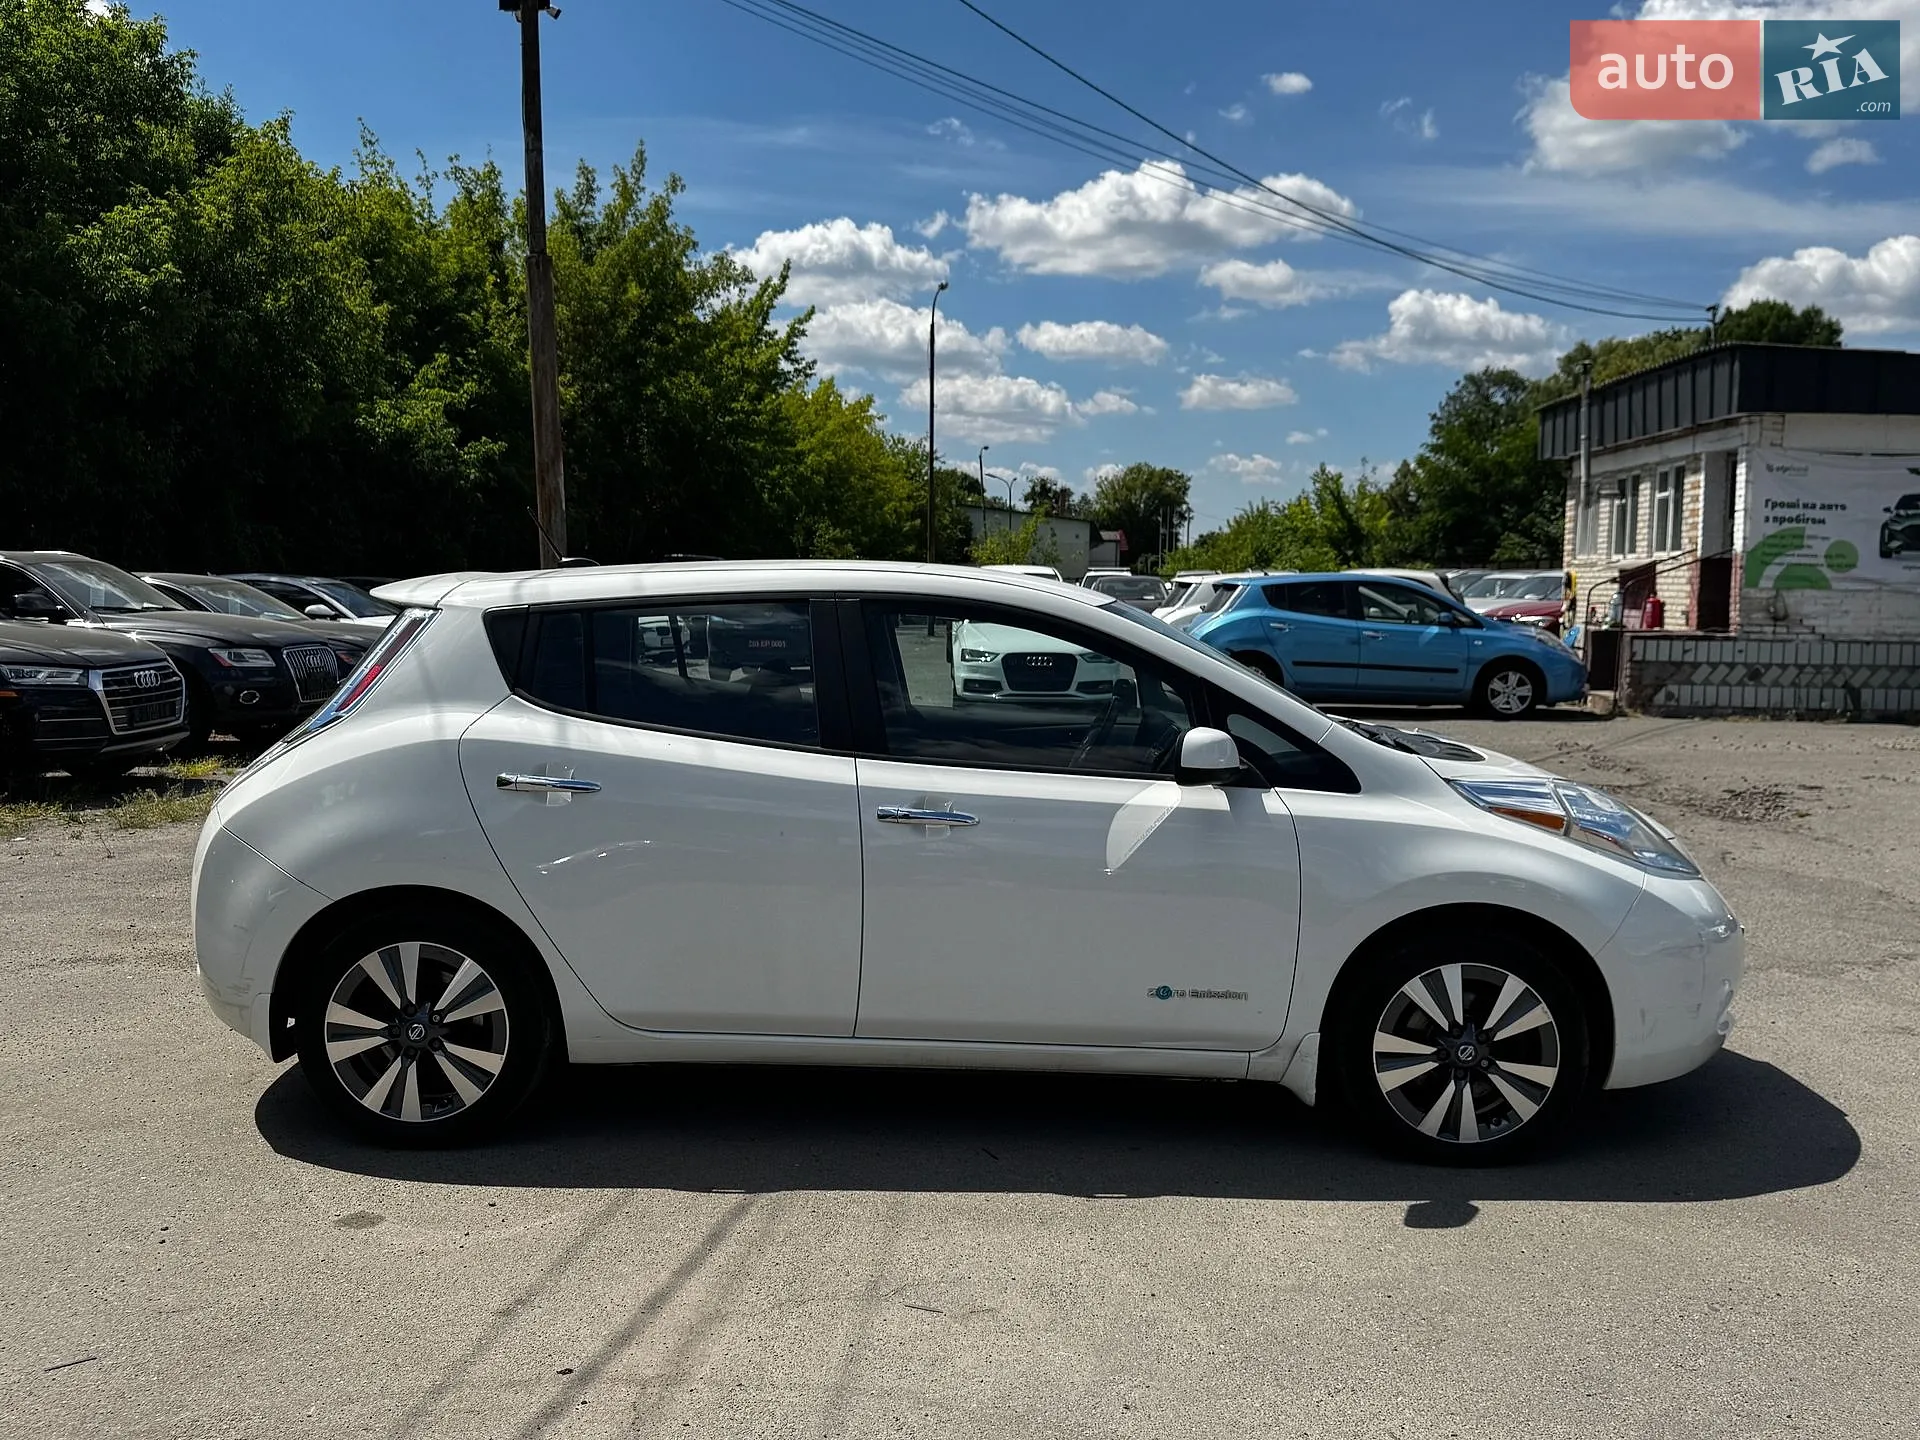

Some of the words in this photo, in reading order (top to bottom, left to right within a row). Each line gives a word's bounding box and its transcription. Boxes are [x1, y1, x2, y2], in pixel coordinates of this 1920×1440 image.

[1764, 498, 1800, 510] Гроші
[1802, 502, 1817, 510] на
[1772, 513, 1826, 525] пробігом
